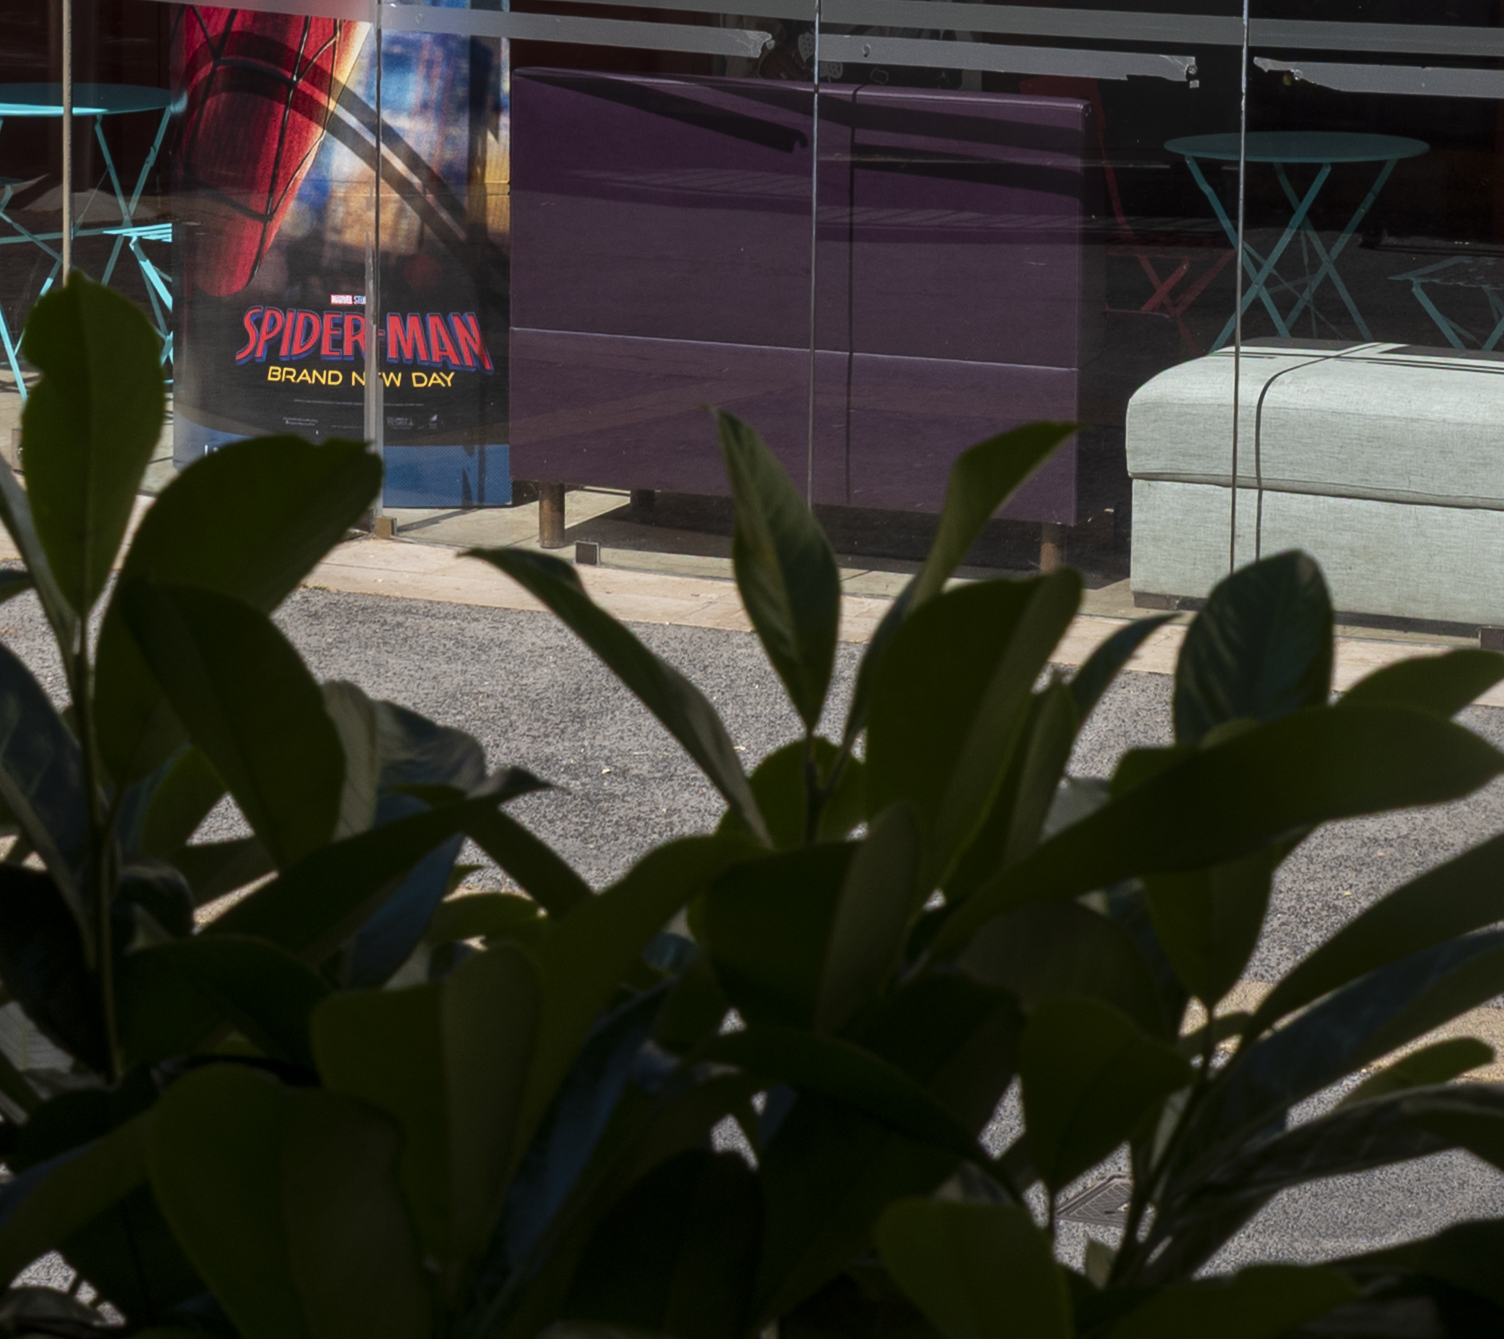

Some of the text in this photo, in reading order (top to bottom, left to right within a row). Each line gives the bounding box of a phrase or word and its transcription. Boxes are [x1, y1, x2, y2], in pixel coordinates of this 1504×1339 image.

[330, 294, 352, 304] MARVEL
[235, 305, 494, 375] SPIDER-MAN
[268, 366, 455, 387] BRAND NW DAY
